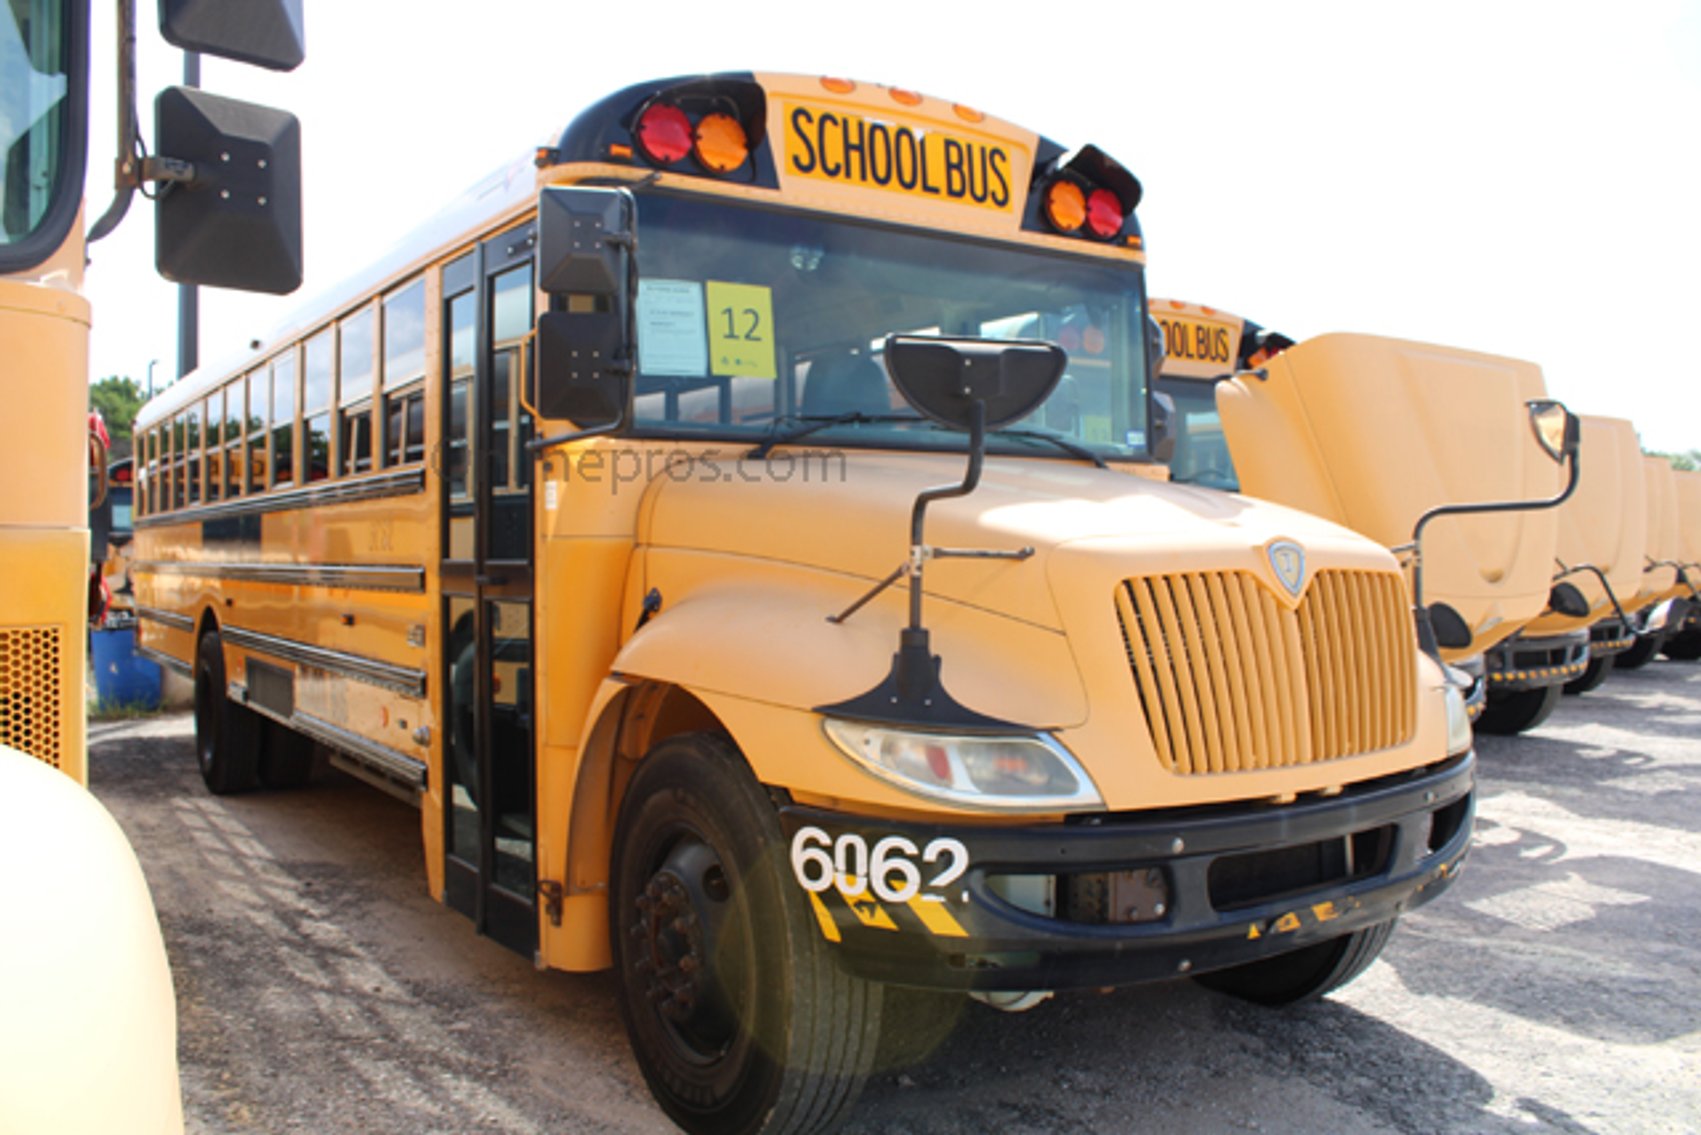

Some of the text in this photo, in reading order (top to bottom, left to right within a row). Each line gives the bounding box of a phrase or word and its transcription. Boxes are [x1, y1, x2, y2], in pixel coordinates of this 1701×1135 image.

[790, 107, 1010, 208] SCHOOL BUS
[720, 306, 763, 342] 12
[1195, 325, 1230, 363] BUS
[790, 826, 969, 903] 6062
